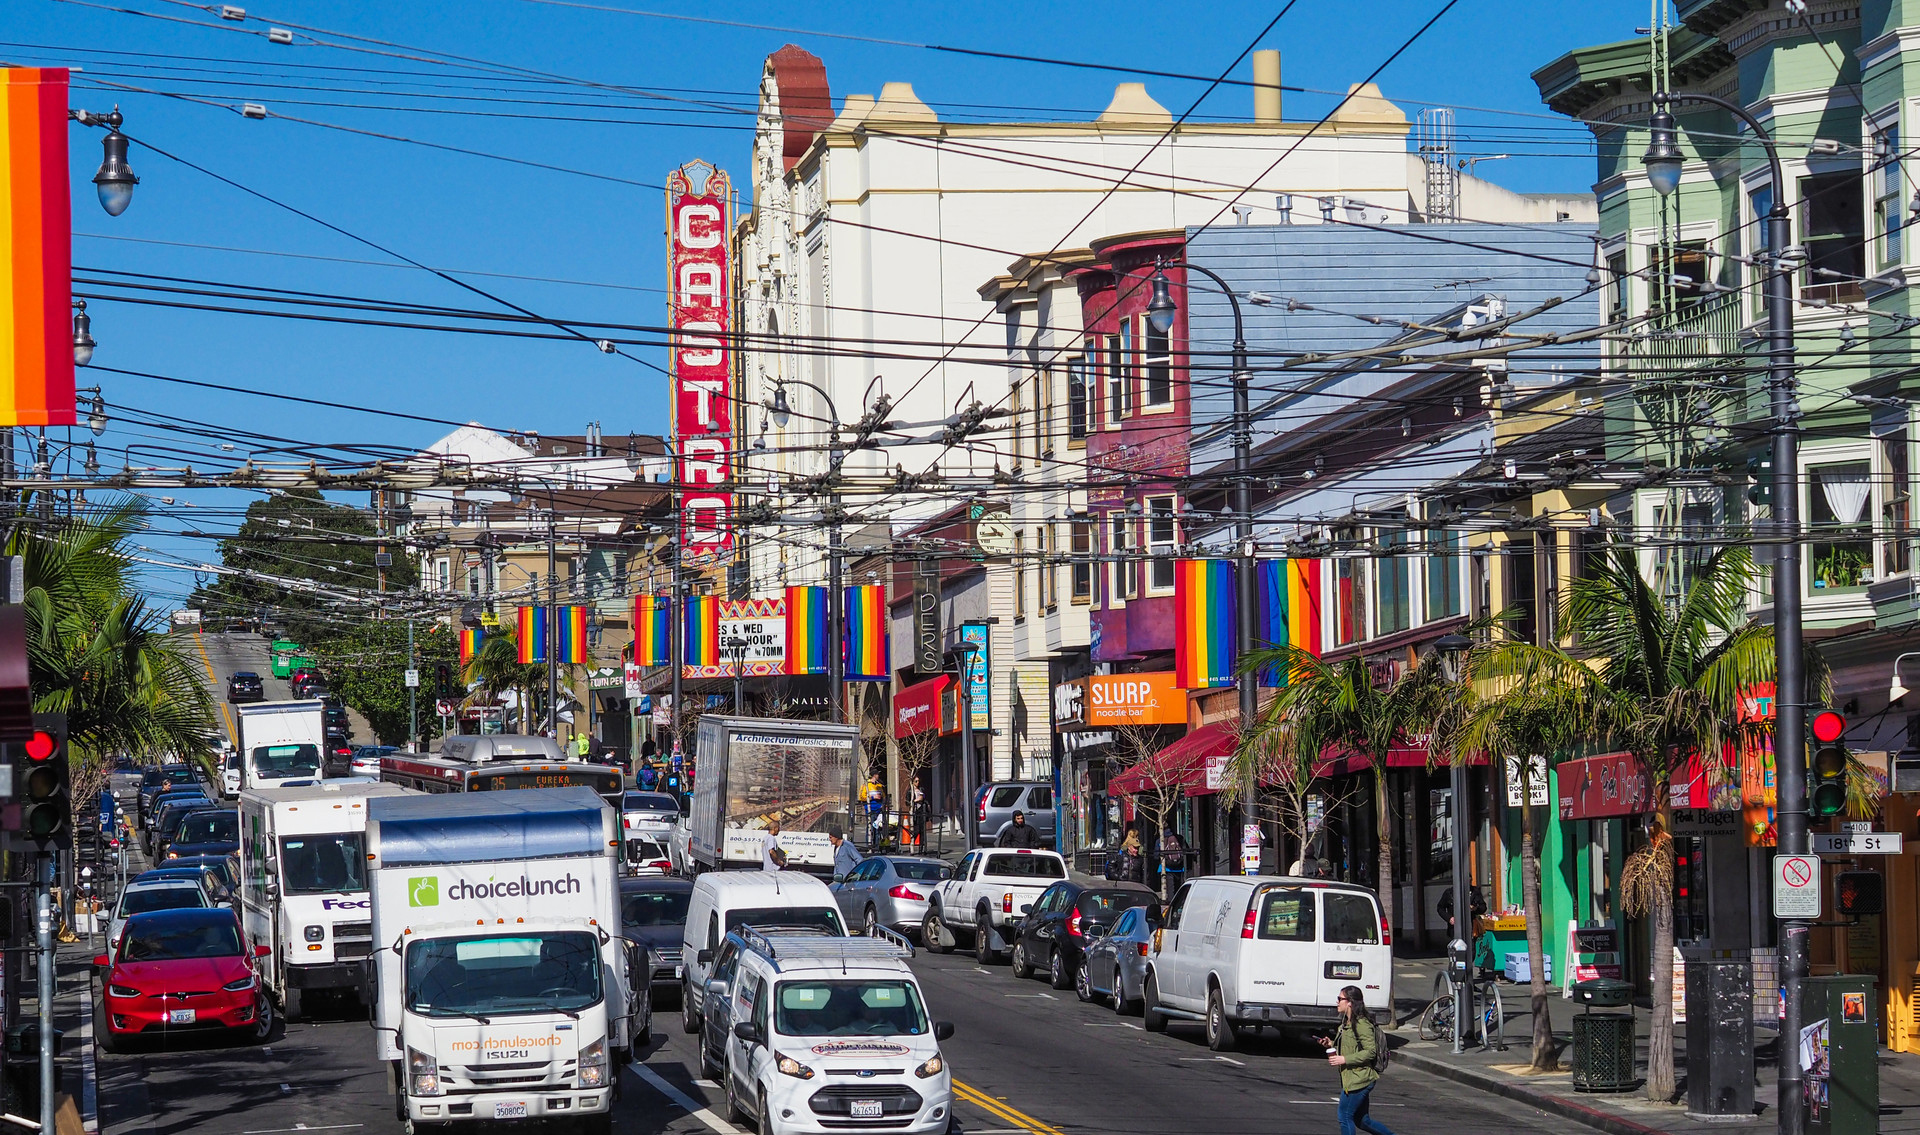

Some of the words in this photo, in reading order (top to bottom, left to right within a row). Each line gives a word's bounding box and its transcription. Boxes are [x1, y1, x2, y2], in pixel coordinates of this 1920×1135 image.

[679, 204, 726, 543] CASTRO
[732, 625, 738, 634] &
[743, 624, 762, 633] WED
[762, 647, 783, 656] 70MM
[590, 678, 609, 687] TWIN
[1092, 682, 1151, 705] SLURP
[791, 697, 829, 705] NAILS
[1096, 709, 1127, 717] noodle
[1129, 708, 1144, 716] bar
[491, 776, 506, 790] 35
[536, 775, 570, 784] EUREKA
[1699, 809, 1735, 826] Bagel
[1851, 821, 1868, 831] 4100
[1828, 838, 1855, 850] 18th
[1865, 838, 1881, 849] St
[449, 873, 581, 900] choicelunch
[487, 1050, 529, 1060] ISUZU
